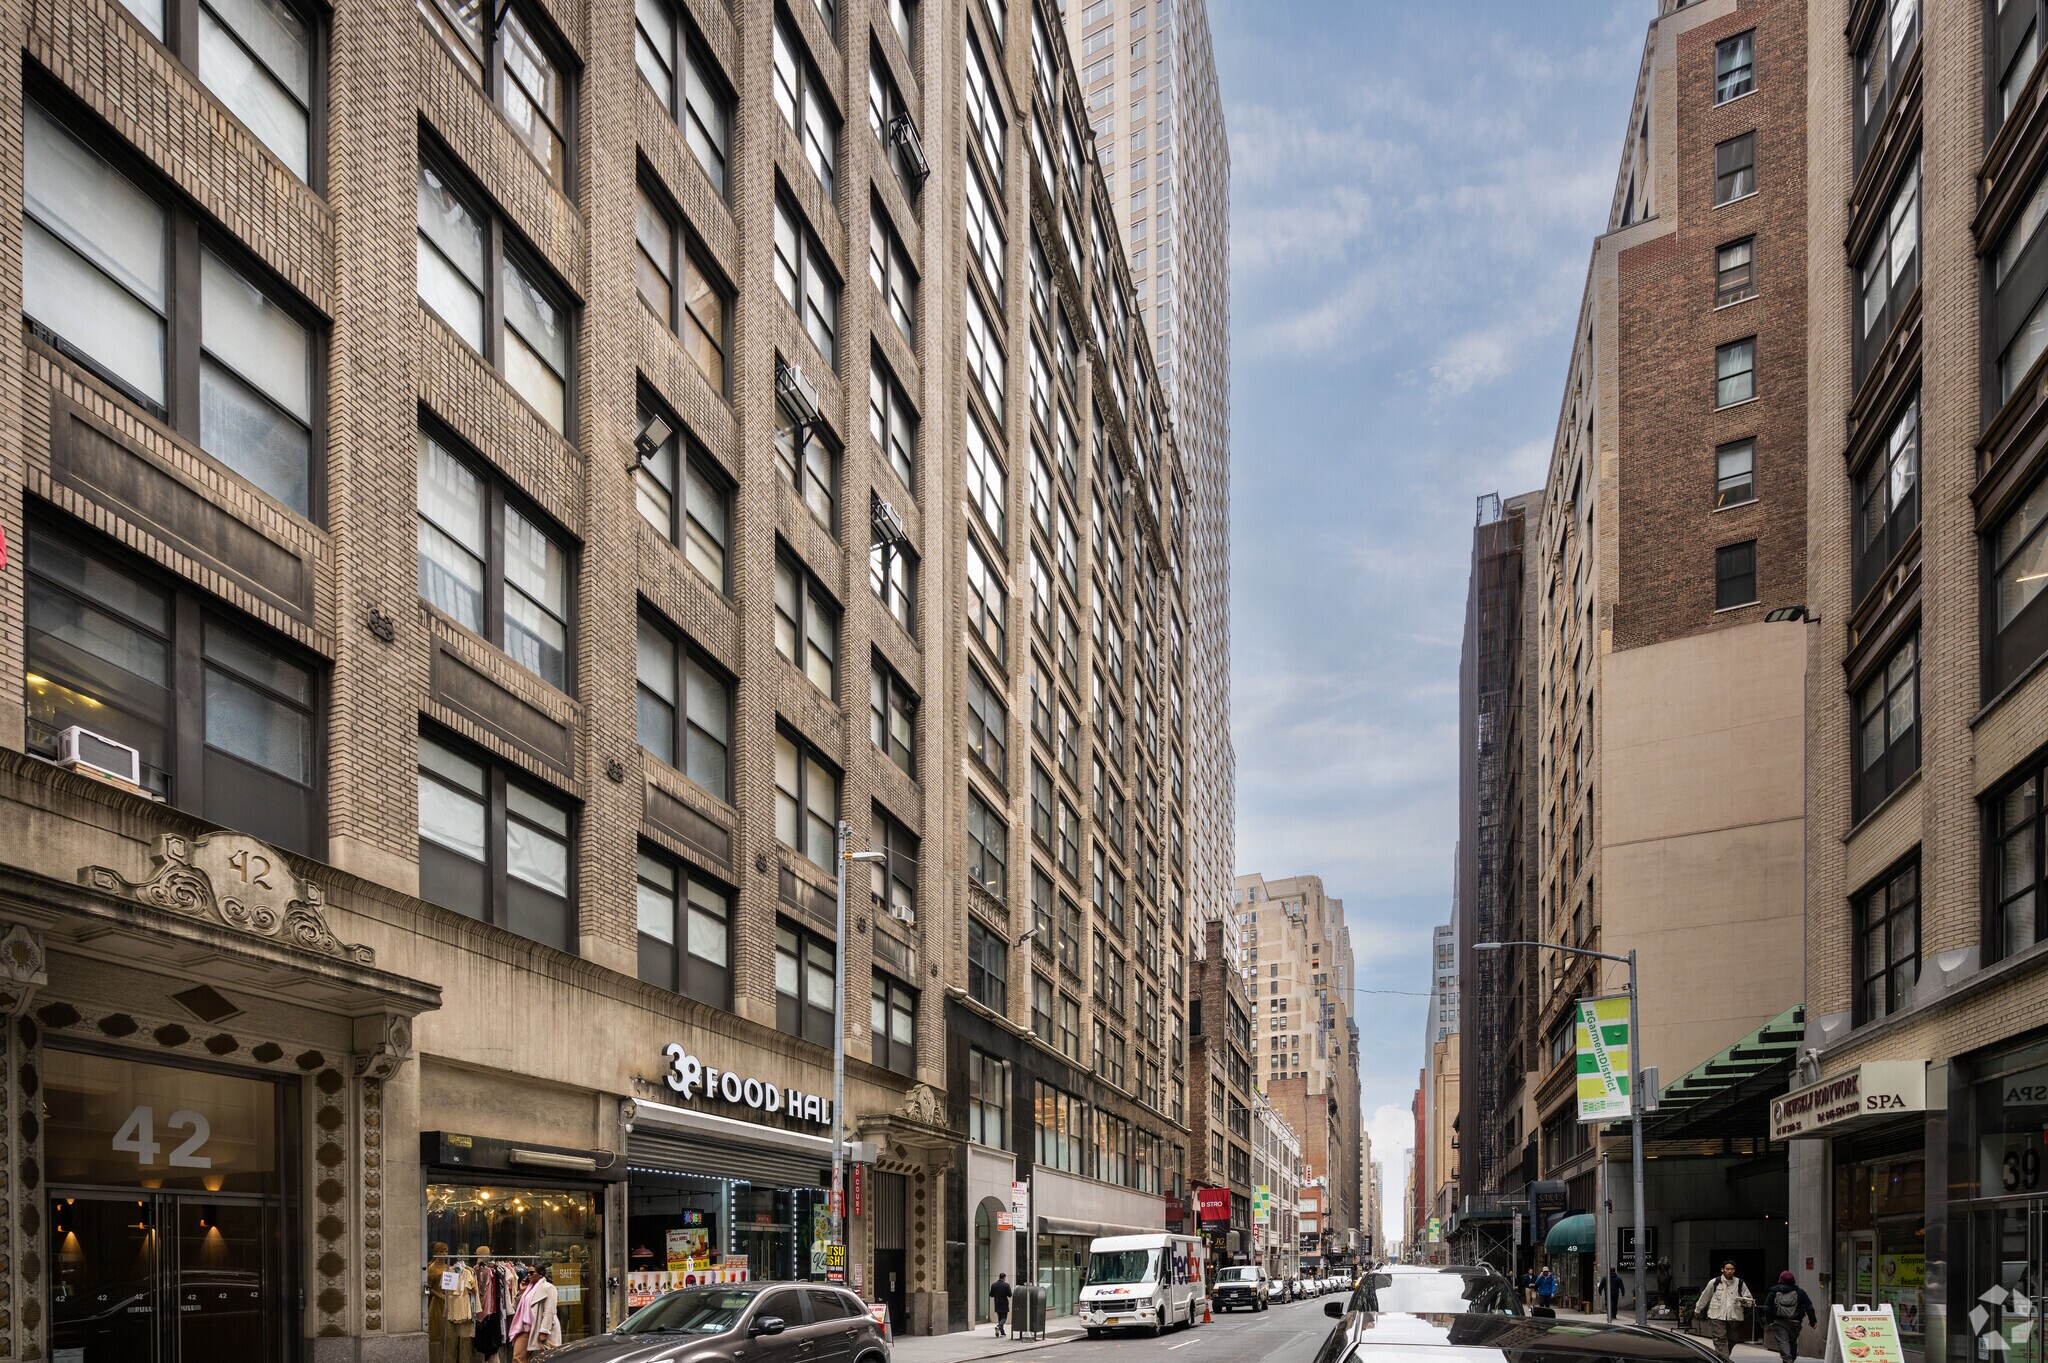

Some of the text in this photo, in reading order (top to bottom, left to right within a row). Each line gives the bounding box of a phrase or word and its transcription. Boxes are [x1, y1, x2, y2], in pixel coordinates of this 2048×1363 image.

[228, 850, 272, 890] 42
[1585, 1009, 1616, 1092] #GarmentDistrict
[705, 1066, 780, 1113] FOOD
[787, 1088, 832, 1125] HAL
[1814, 1074, 1859, 1108] BODYWORK
[1867, 1094, 1905, 1110] SPA
[112, 1105, 212, 1169] 42
[2003, 1148, 2040, 1192] 39
[560, 1268, 573, 1279] SALE
[1171, 1241, 1201, 1285] FedEx
[1095, 1288, 1131, 1296] FedEx
